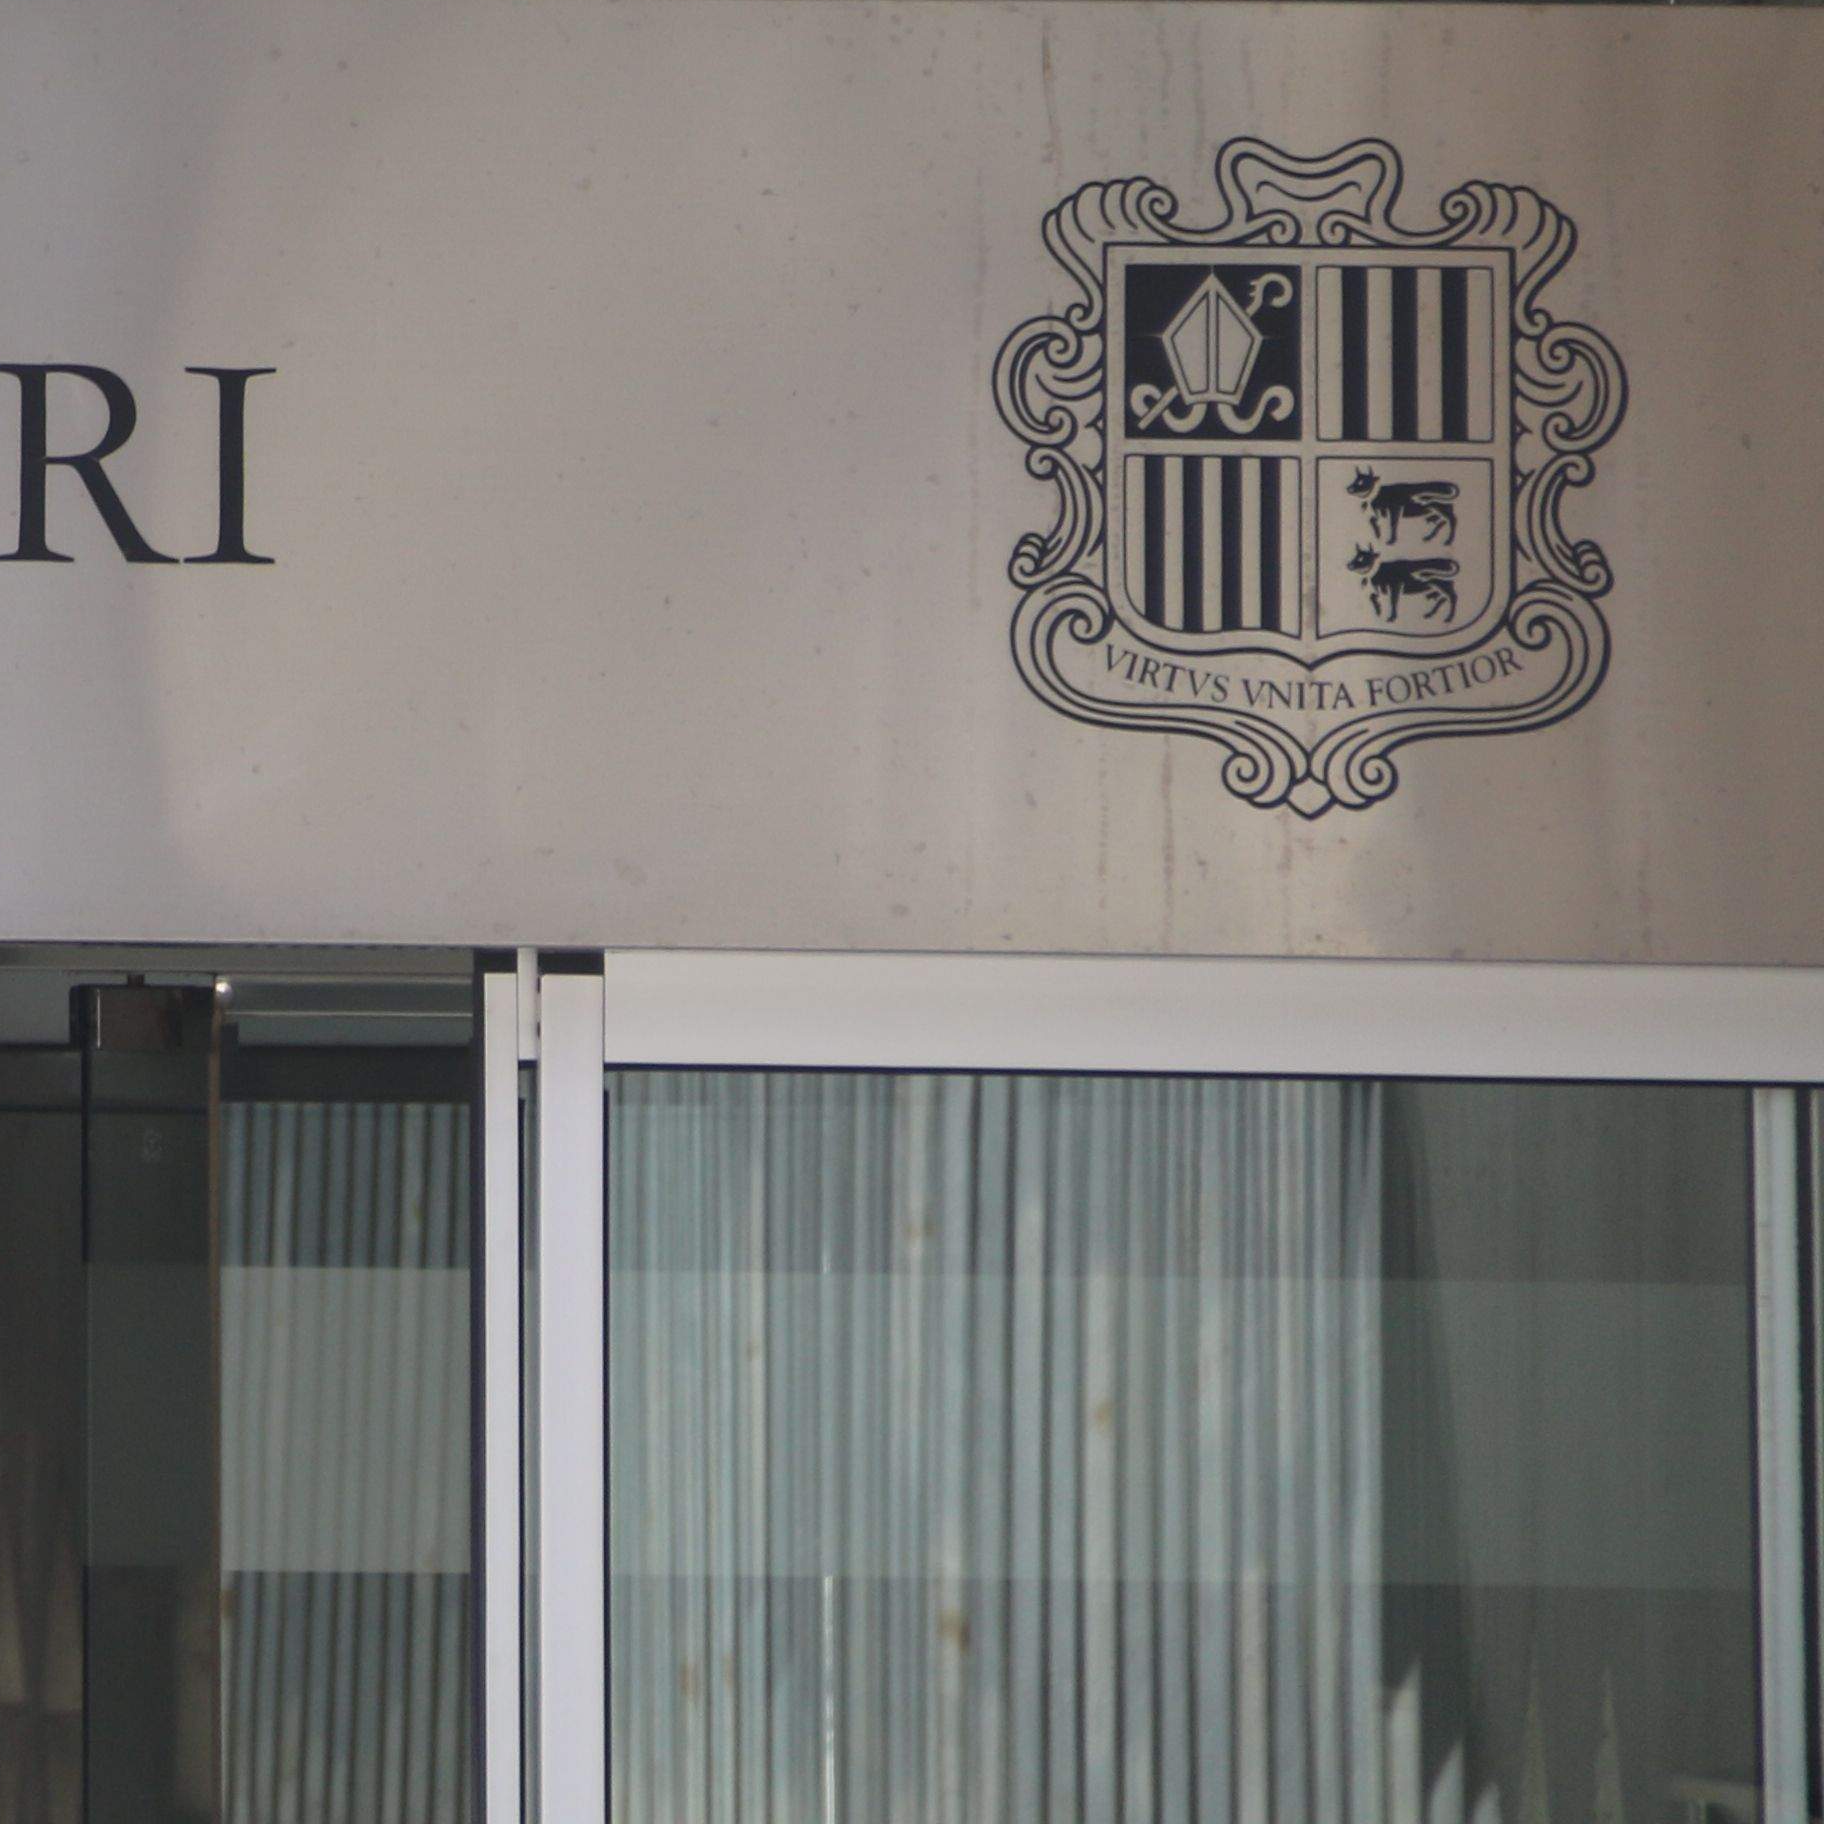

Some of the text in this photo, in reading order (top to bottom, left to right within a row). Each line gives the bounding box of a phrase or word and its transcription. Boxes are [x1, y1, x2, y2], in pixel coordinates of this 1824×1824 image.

[1104, 643, 1524, 711] VIRTVS VNITA FORTIOR
